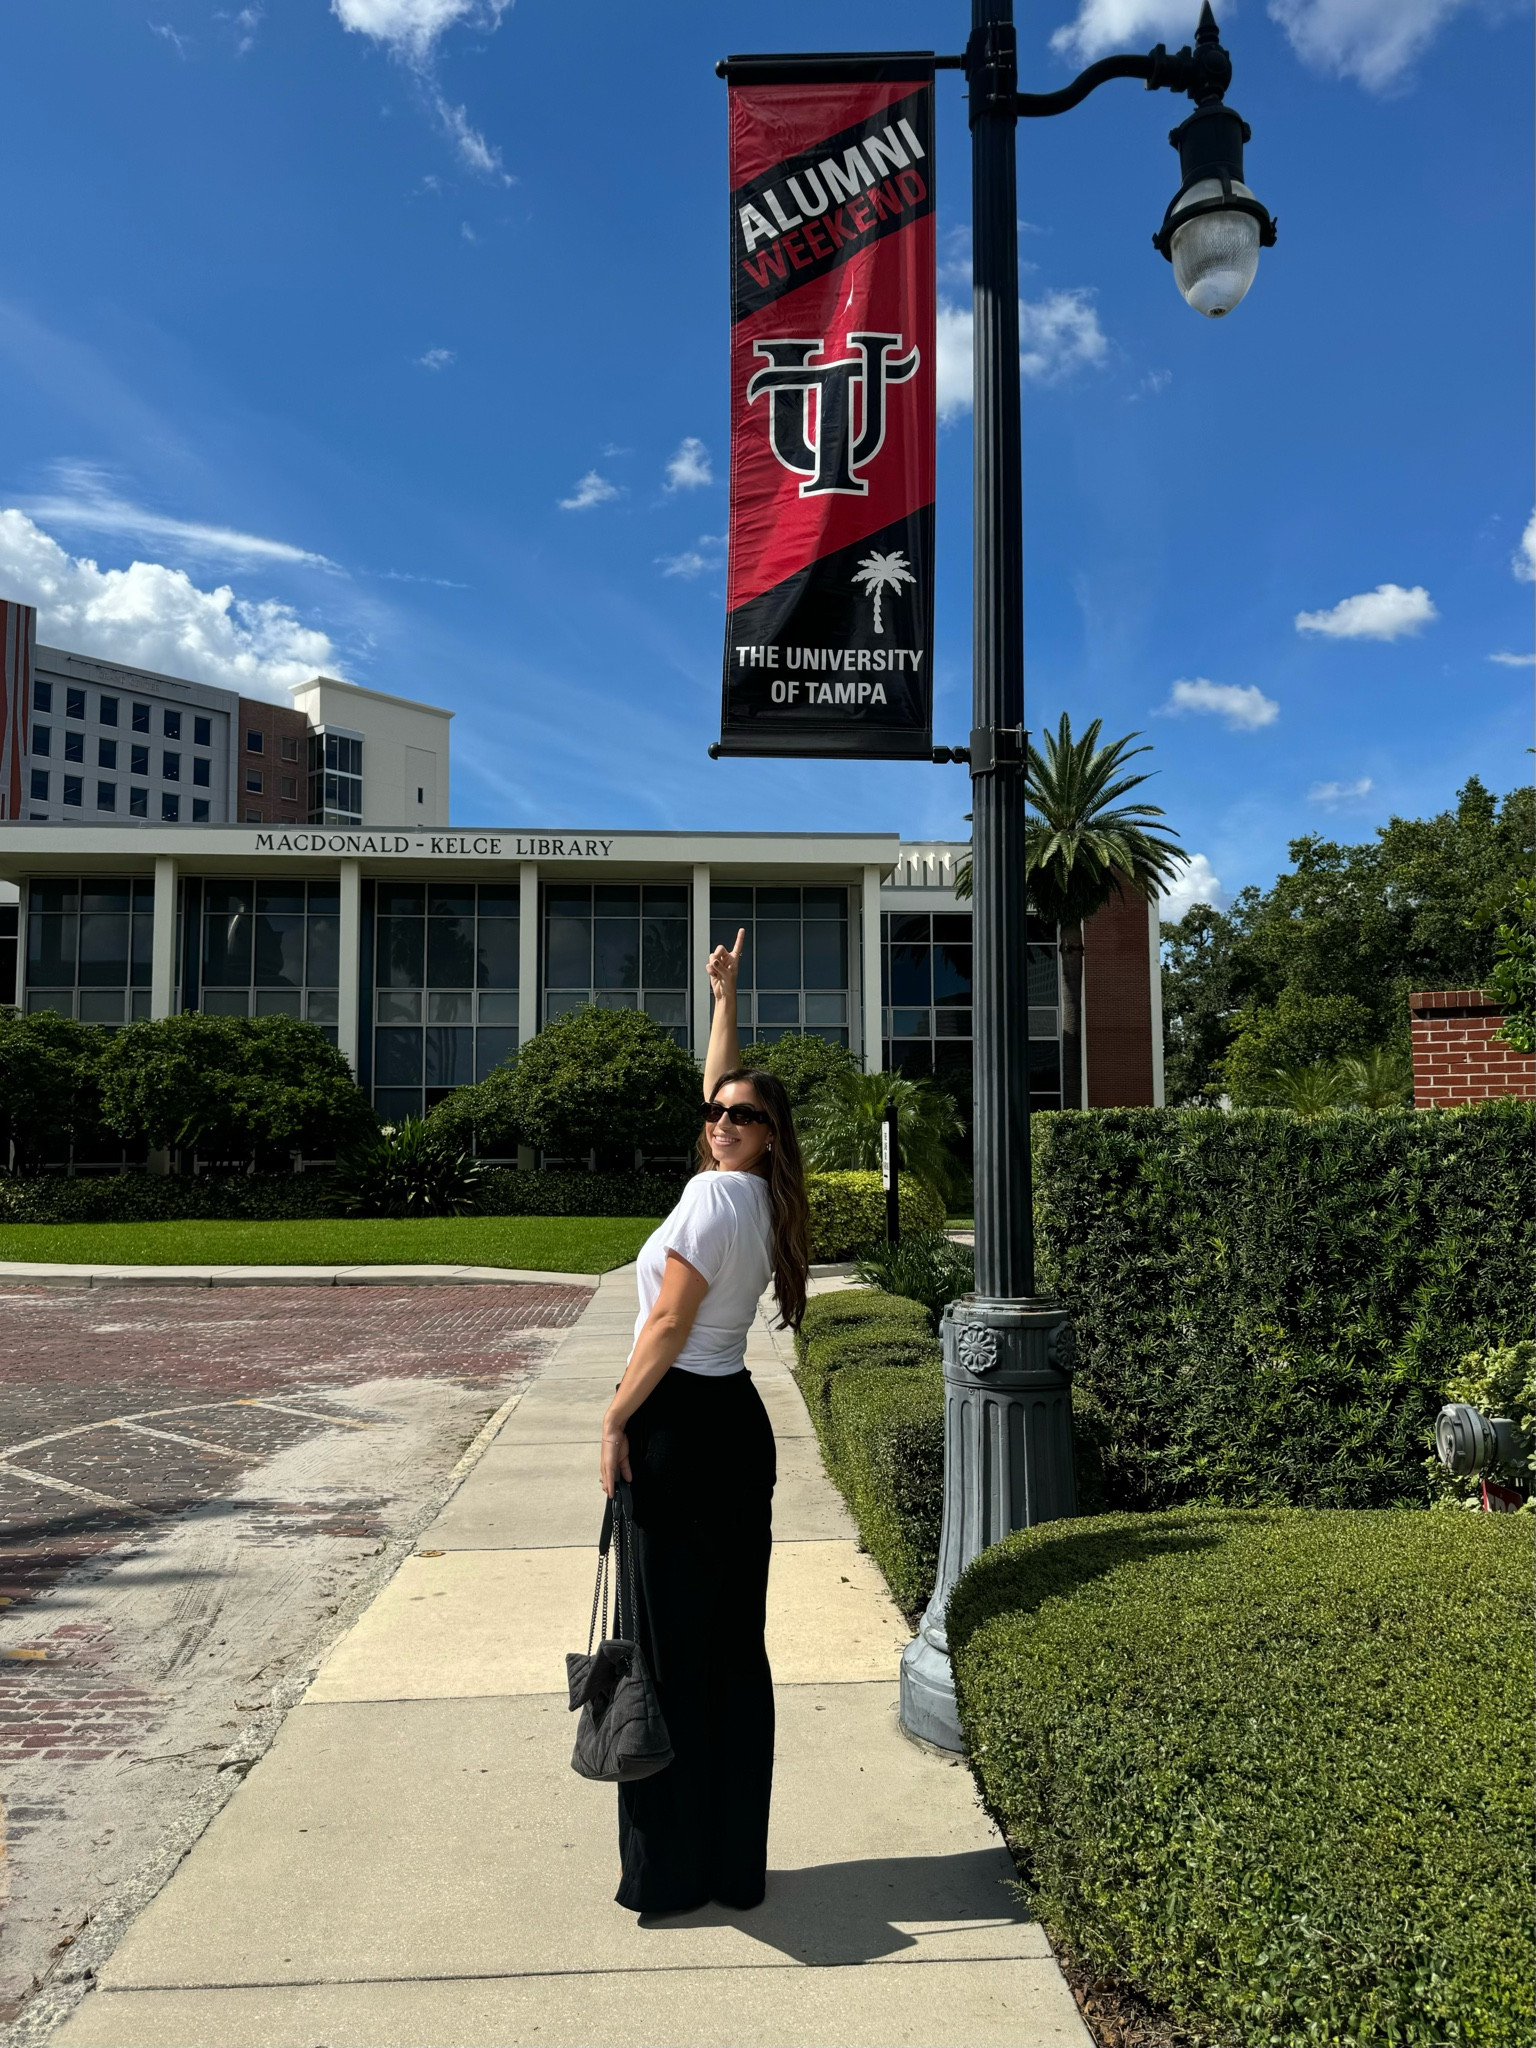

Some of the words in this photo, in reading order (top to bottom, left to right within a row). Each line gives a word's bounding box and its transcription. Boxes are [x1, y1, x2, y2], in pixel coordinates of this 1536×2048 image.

[738, 117, 926, 253] ALUMNI
[741, 168, 928, 289] WEEKEND
[735, 645, 779, 669] THE
[786, 646, 924, 672] UNIVERSITY
[771, 680, 800, 704] OF
[804, 682, 888, 705] TAMPA
[515, 838, 614, 856] LIBRARY
